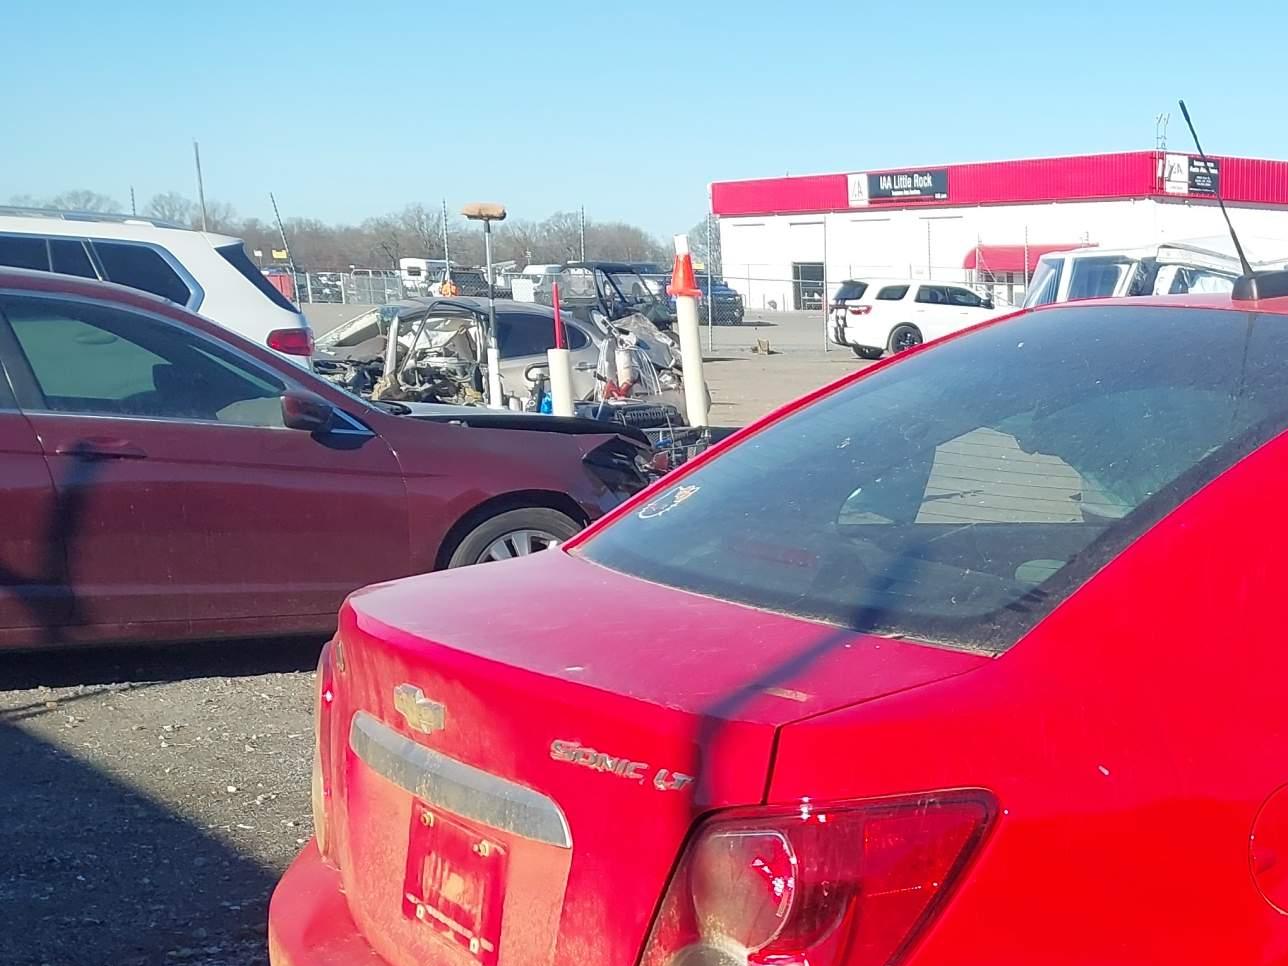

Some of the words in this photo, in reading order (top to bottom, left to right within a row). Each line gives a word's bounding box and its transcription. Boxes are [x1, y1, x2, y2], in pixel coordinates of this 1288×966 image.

[880, 175, 893, 190] IAA
[893, 173, 912, 189] Little
[913, 171, 933, 188] Rock
[550, 739, 648, 779] SONIC
[653, 768, 695, 791] LT
